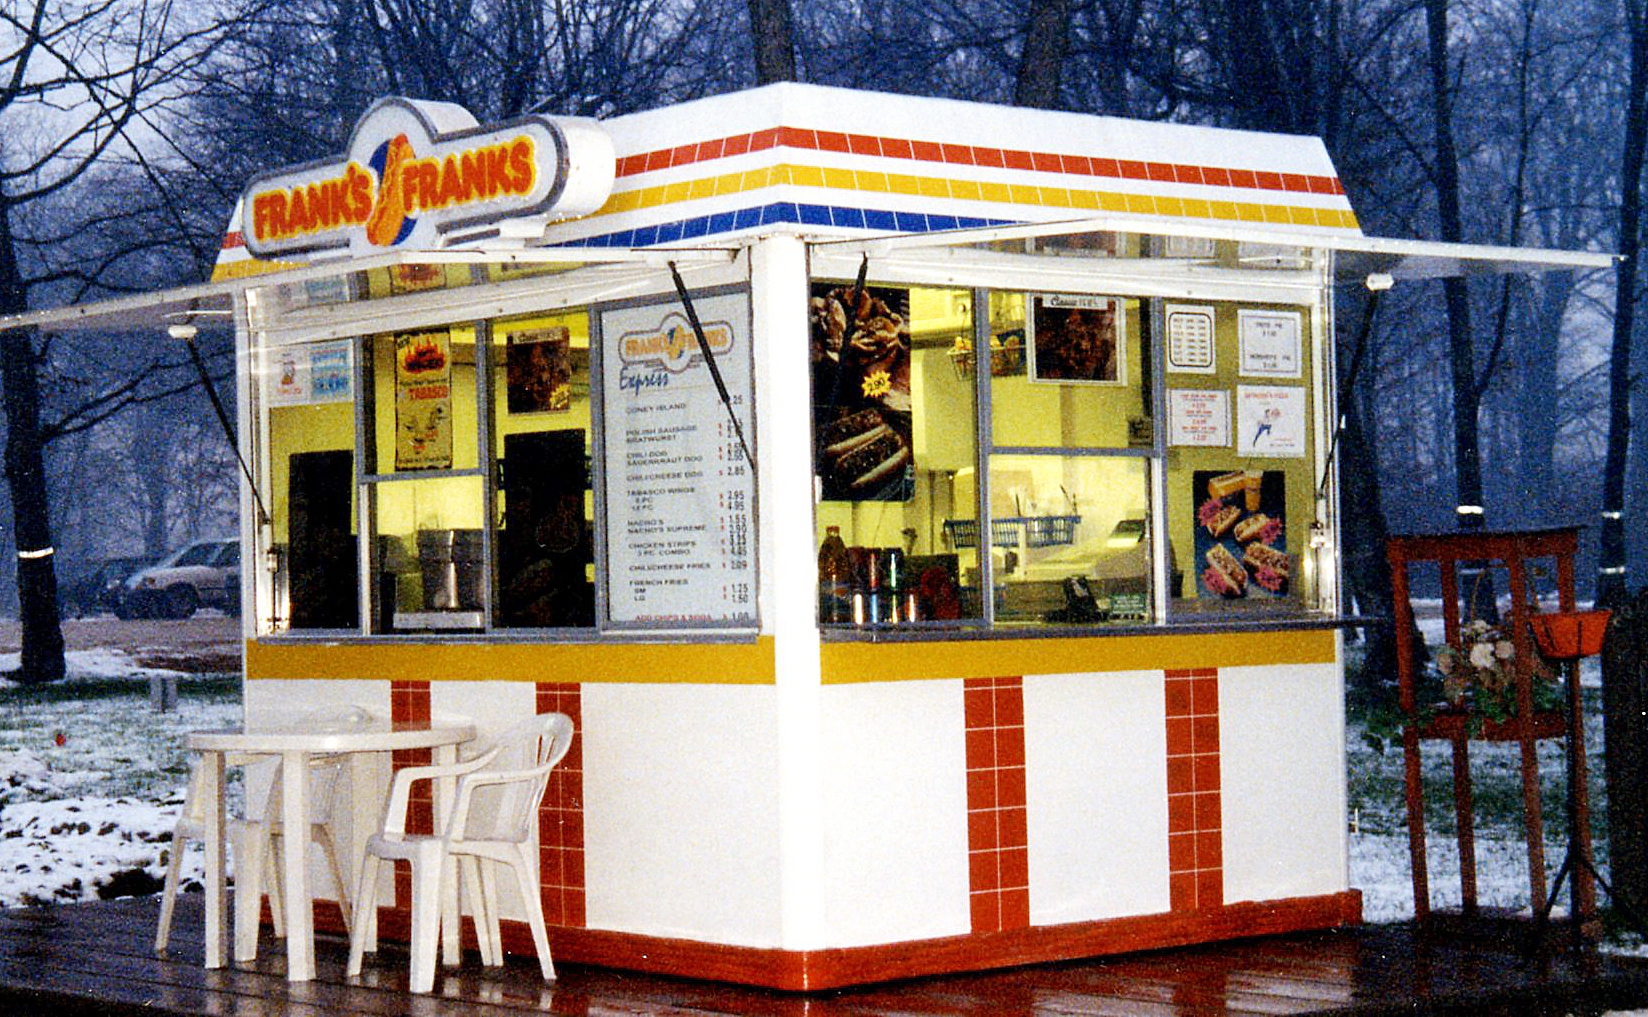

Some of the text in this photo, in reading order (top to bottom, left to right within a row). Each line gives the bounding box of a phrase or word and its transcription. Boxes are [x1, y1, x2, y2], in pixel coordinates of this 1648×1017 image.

[252, 134, 537, 241] FRANK'S FRANKS
[619, 365, 669, 397] Express
[656, 403, 687, 412] ISLAND
[658, 424, 698, 434] SAUSAGE
[626, 434, 677, 444] BRATWURST
[684, 470, 704, 478] DOG
[627, 486, 696, 497] TABASCO WINGS
[666, 524, 707, 533] SUPREME
[628, 540, 697, 550] CHICKEN STRIPS
[686, 562, 711, 571] FRIES
[629, 578, 689, 587] FRENCH FRIES
